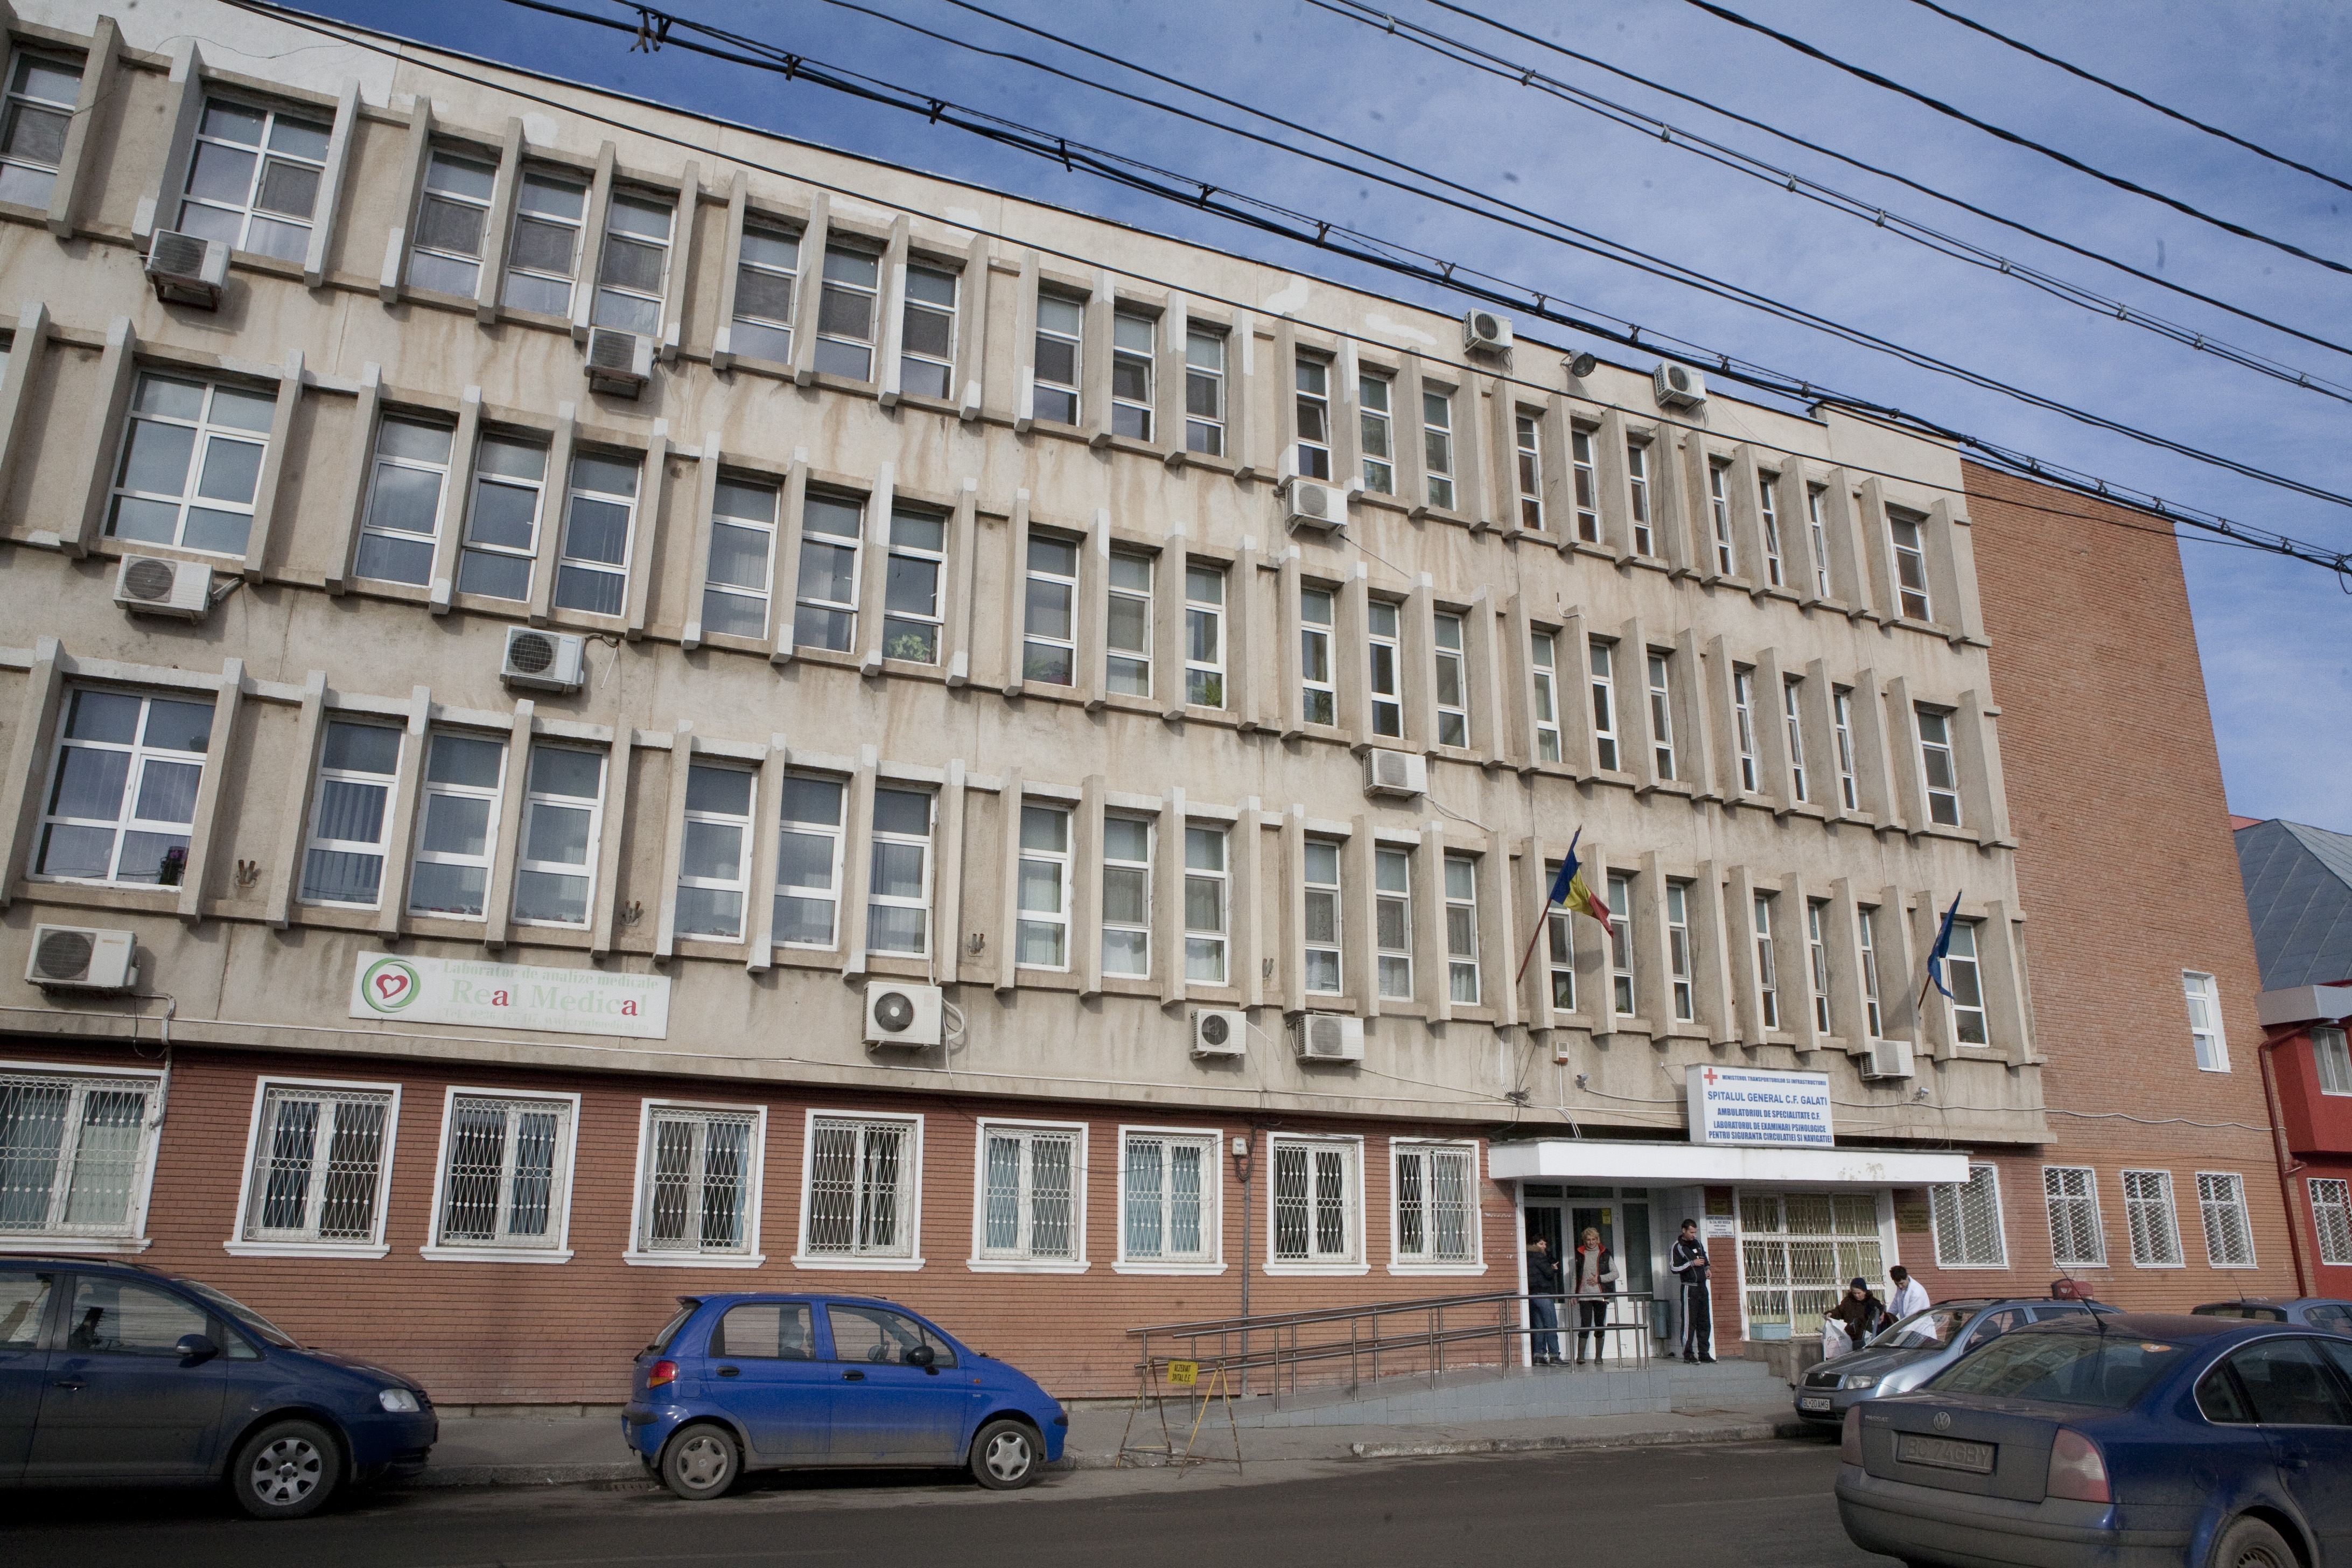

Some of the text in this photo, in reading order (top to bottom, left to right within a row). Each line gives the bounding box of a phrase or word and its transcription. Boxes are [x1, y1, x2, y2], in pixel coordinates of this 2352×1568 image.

[443, 961, 659, 989] Laborator de analize medicale
[449, 979, 647, 1017] Real Medical
[1707, 1091, 1828, 1105] SPITALUL GENERAL C.F. GALATI
[1717, 1108, 1821, 1120] AMBULATORIUL DE SPECIALITATE C.F.
[1713, 1121, 1826, 1133] LABORATORUL DE EXAMINARI PSIHOLOGICE
[1709, 1131, 1832, 1143] PENTRU SIGURANTA CIRCULATIEI SI NAVIGATIEI
[1174, 1364, 1191, 1372] REZERVAT
[1172, 1373, 1184, 1382] SPITAL
[1865, 1415, 1889, 1423] PASSAT
